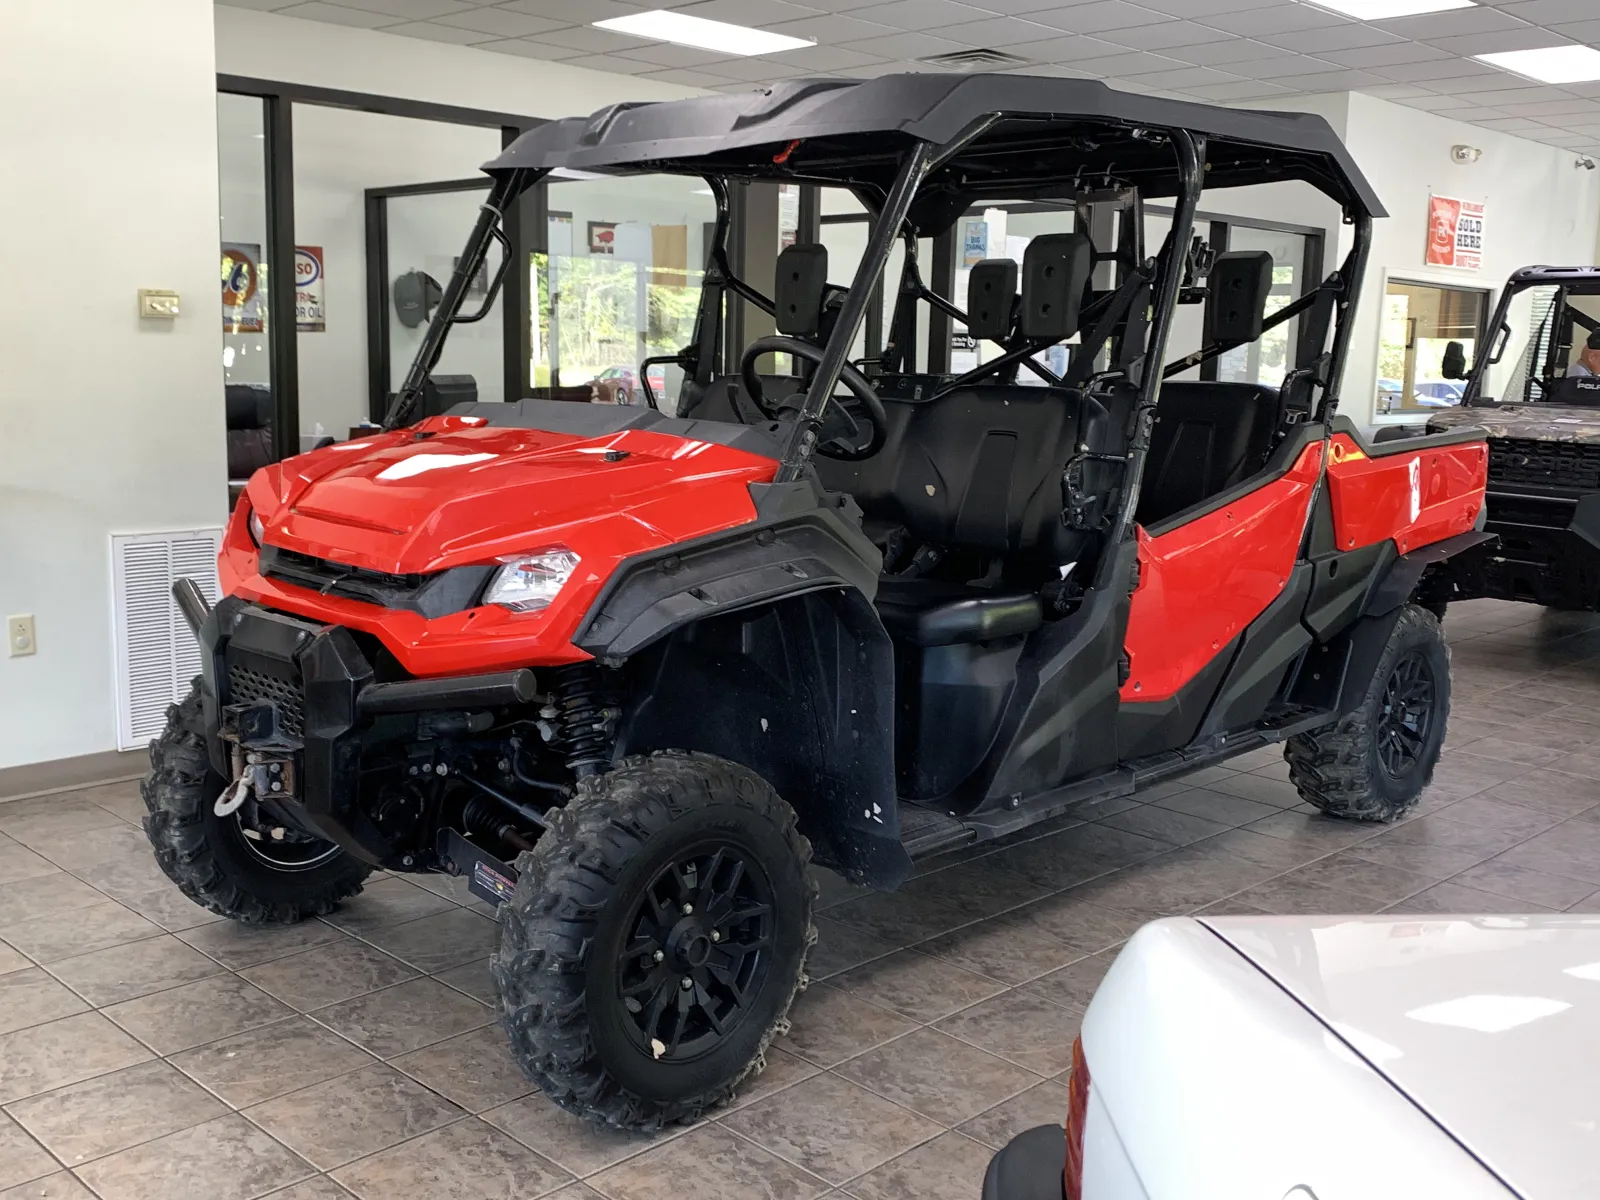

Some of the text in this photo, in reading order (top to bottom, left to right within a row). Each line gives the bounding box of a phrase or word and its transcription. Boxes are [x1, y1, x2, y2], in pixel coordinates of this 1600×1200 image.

[1458, 218, 1482, 233] SOLD
[971, 236, 981, 244] BIG
[1456, 234, 1481, 249] HERE
[965, 243, 987, 252] THANKS
[308, 306, 323, 318] OIL
